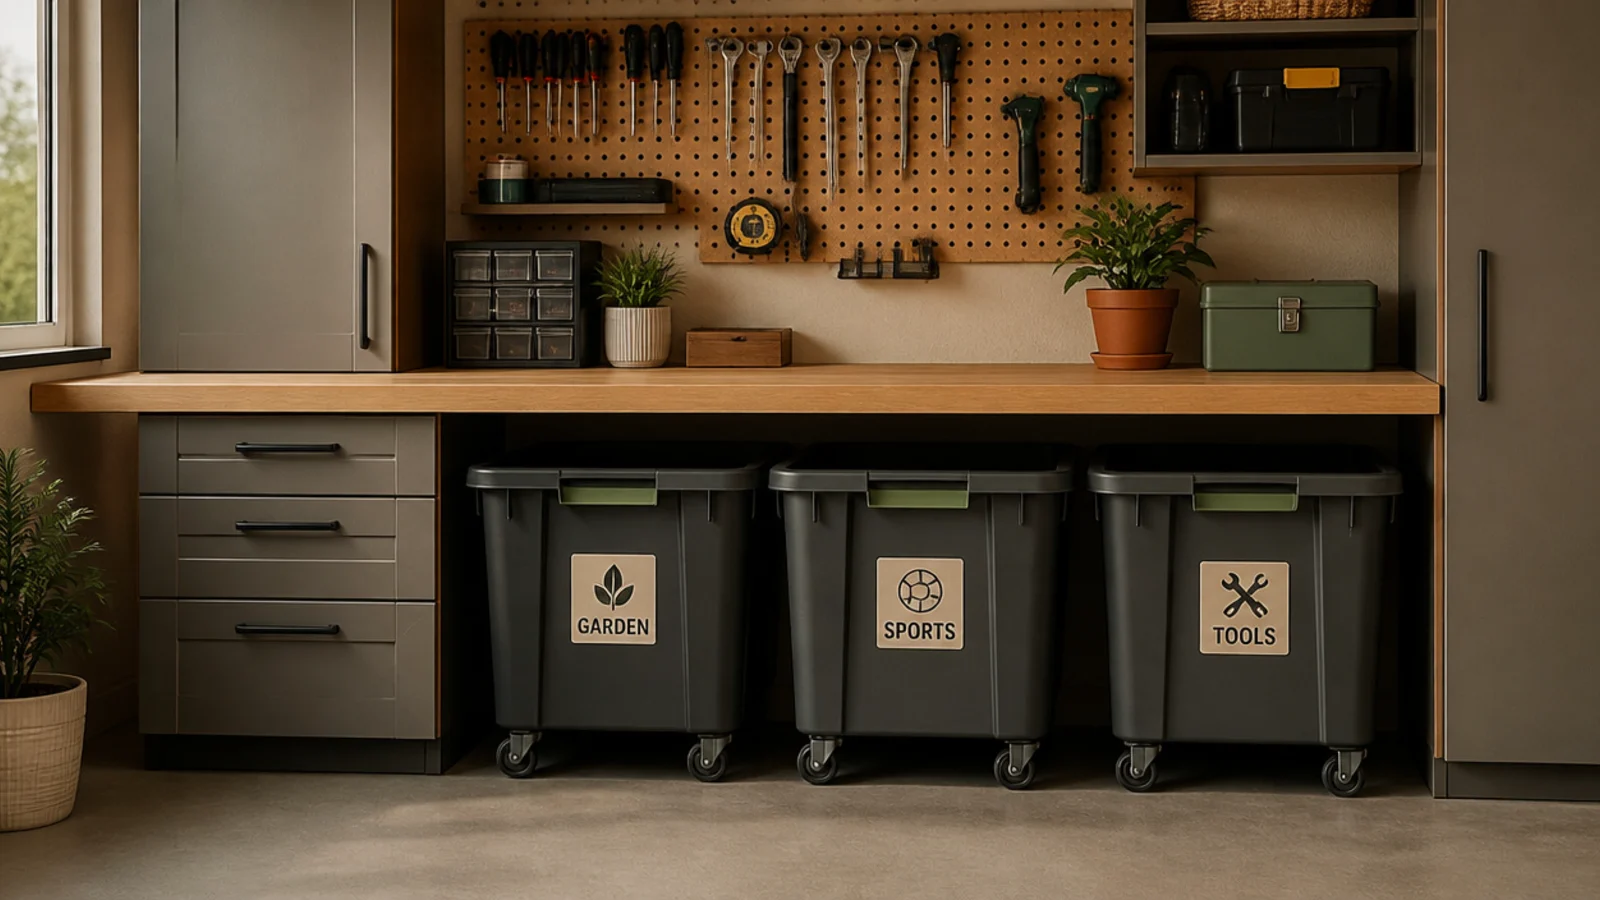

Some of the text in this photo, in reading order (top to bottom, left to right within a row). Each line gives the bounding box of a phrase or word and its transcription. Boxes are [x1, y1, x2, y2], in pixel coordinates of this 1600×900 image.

[577, 617, 649, 635] GARDEN
[884, 622, 956, 640] SPORTS
[1213, 627, 1276, 645] TOOLS
